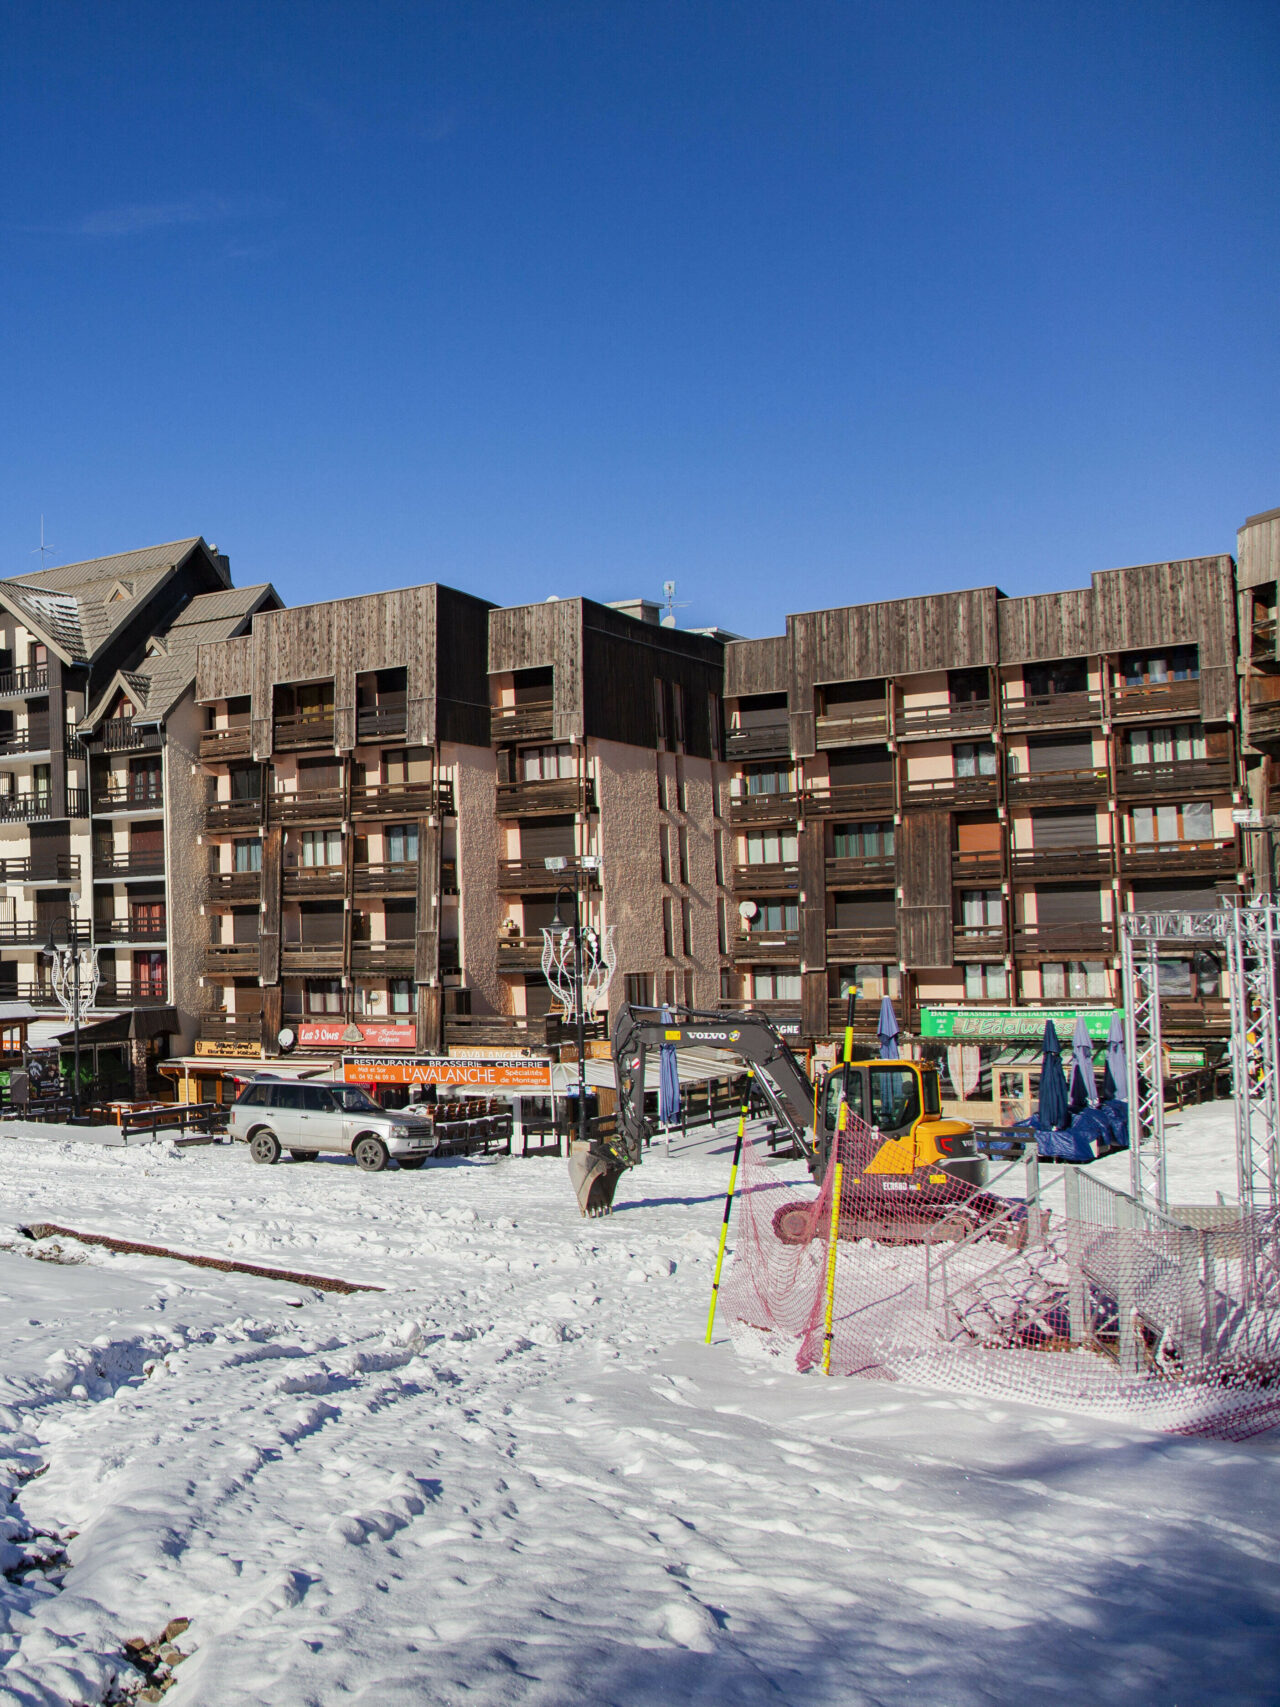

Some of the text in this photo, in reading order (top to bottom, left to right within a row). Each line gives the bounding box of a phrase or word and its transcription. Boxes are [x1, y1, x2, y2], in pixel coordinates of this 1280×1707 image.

[961, 1018, 1073, 1034] L'Edelwess
[314, 1029, 320, 1040] 3
[686, 1032, 727, 1040] VOLVO
[402, 1068, 496, 1083] L'AVALANCHE
[505, 1069, 543, 1077] Spécialités
[512, 1077, 547, 1085] Montagne
